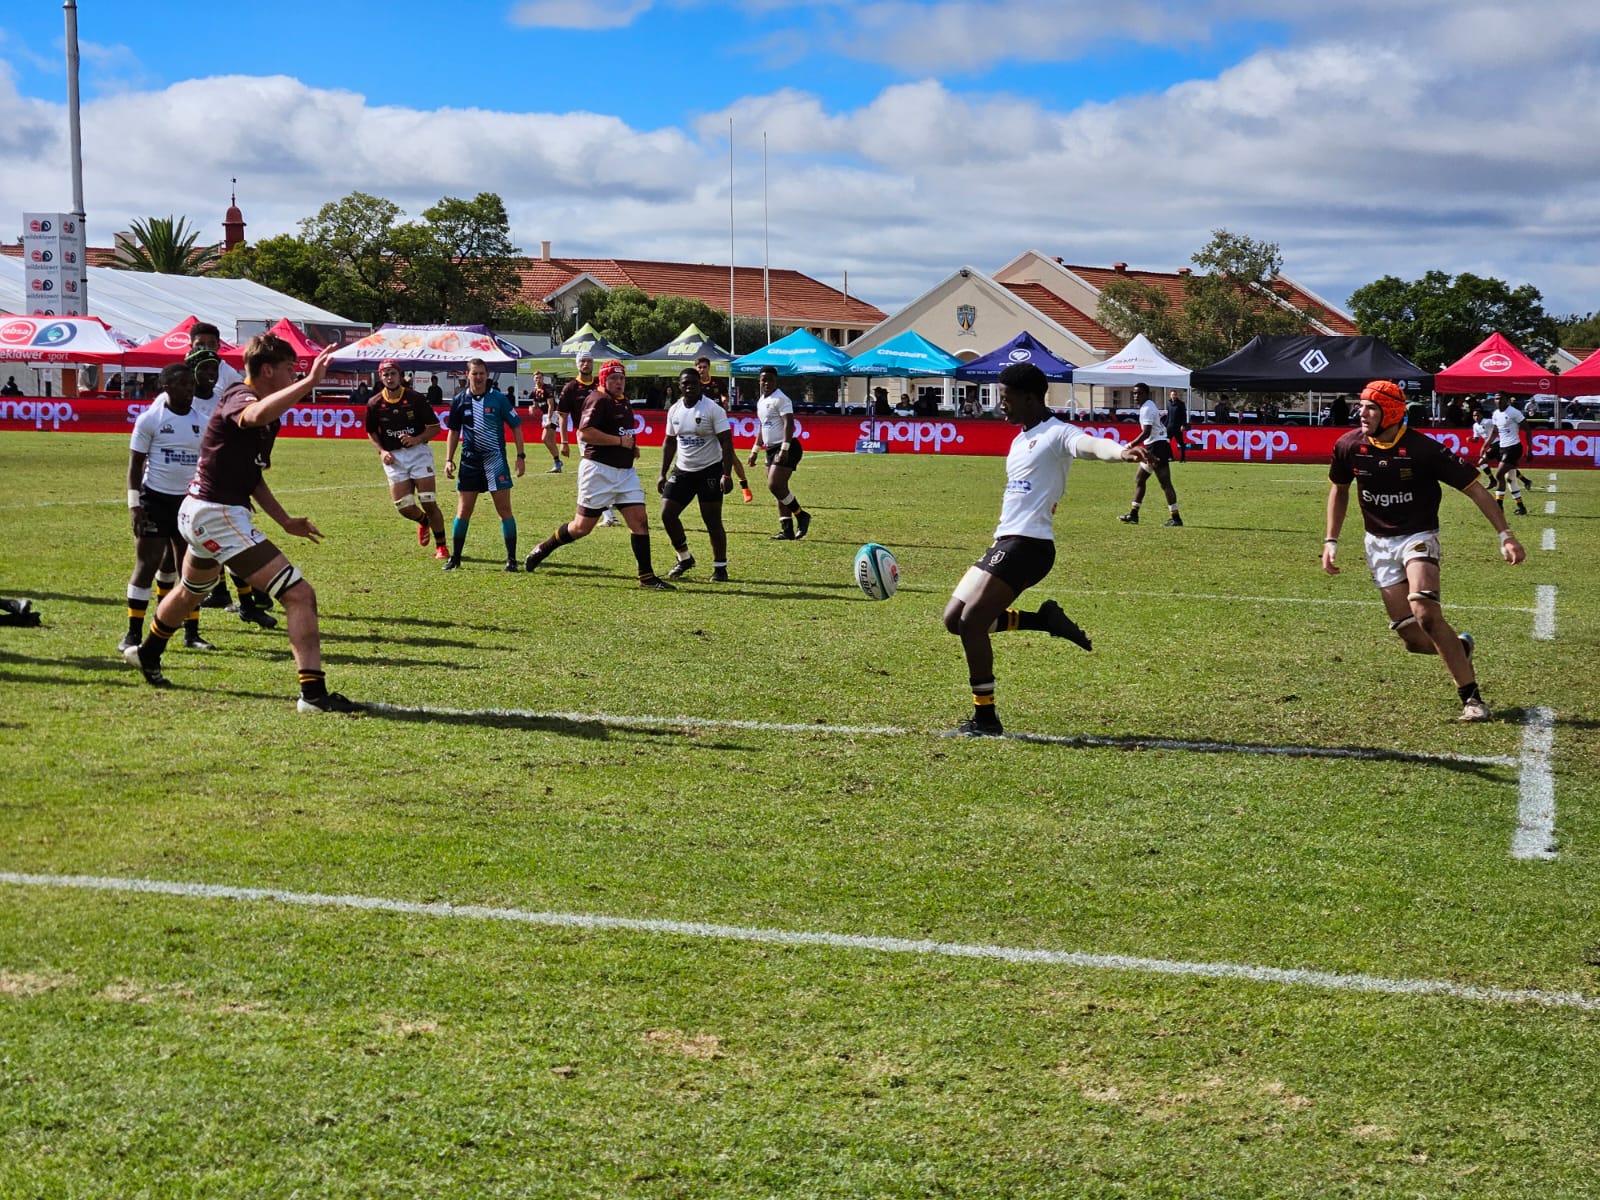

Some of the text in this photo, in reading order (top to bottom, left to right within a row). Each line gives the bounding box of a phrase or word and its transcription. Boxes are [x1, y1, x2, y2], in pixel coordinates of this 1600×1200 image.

[47, 352, 69, 362] sport
[876, 348, 929, 359] Checkers
[1483, 359, 1508, 368] absa
[0, 401, 79, 429] napp.
[280, 407, 363, 437] napp.
[859, 420, 965, 452] snapp.
[862, 441, 881, 449] 22M
[1186, 428, 1298, 461] snapp.
[1362, 489, 1414, 507] Sygnia
